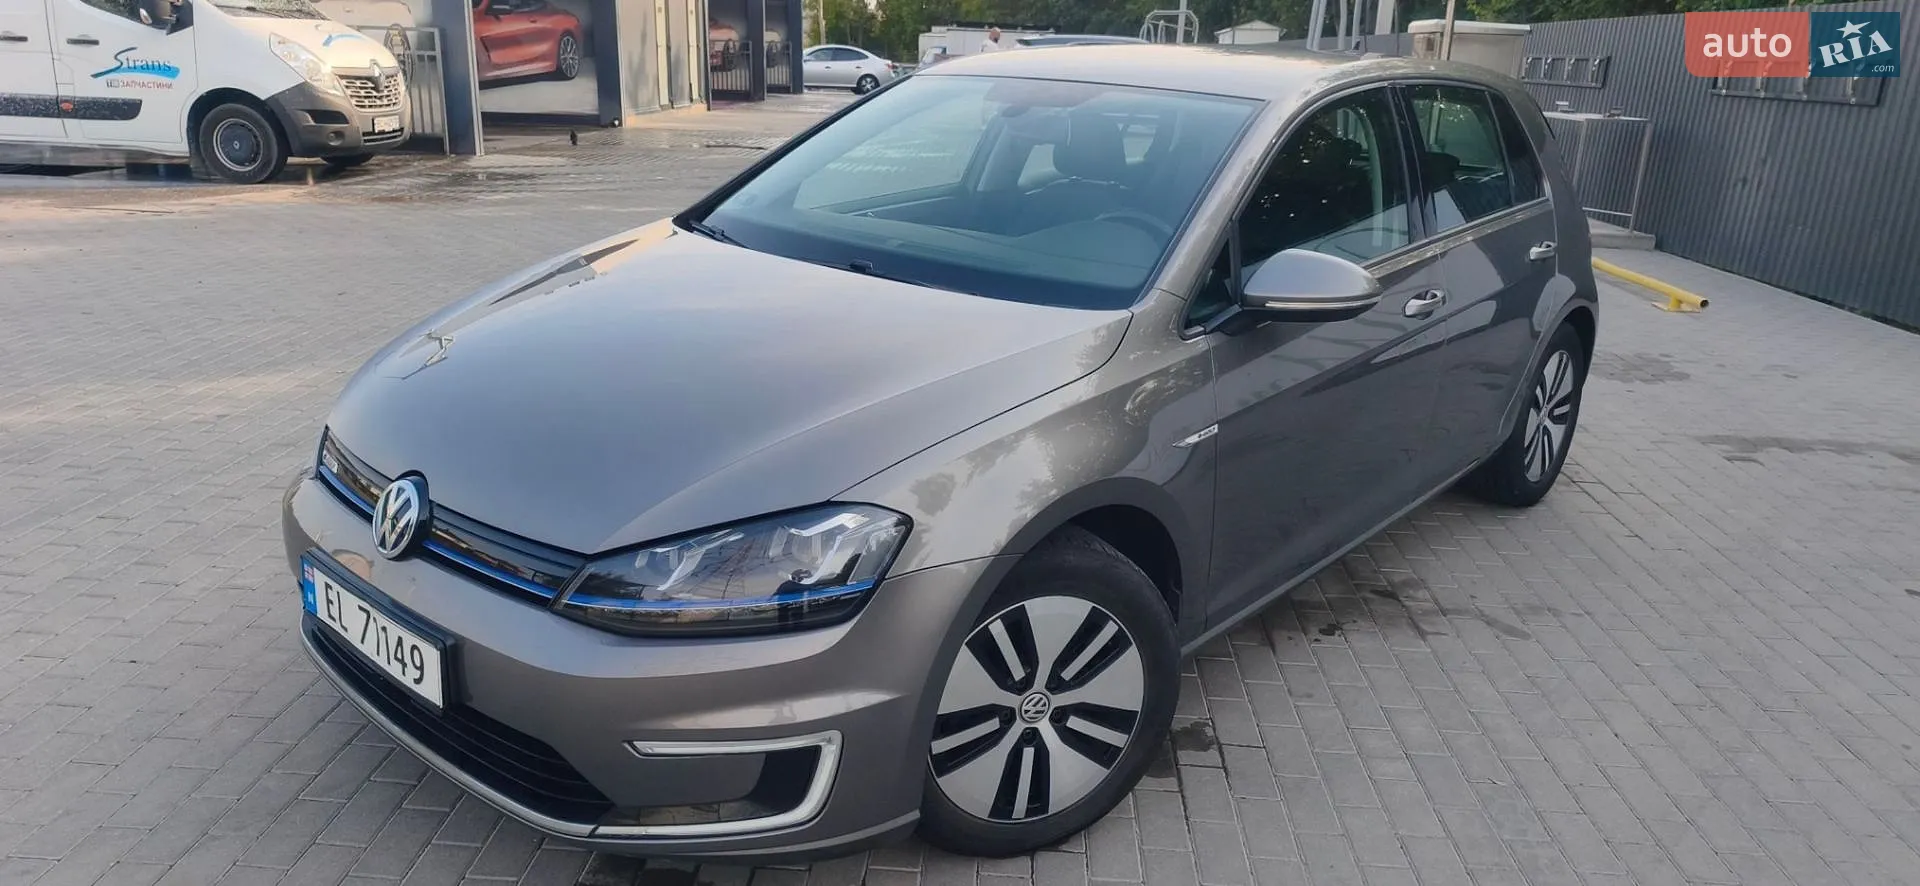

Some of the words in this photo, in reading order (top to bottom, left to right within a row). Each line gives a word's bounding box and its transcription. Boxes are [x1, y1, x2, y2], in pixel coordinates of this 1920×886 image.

[90, 47, 172, 78] Strans
[120, 80, 173, 89] ЗАПЧАСТИНИ
[324, 581, 348, 633] EL
[358, 604, 424, 685] 71149
